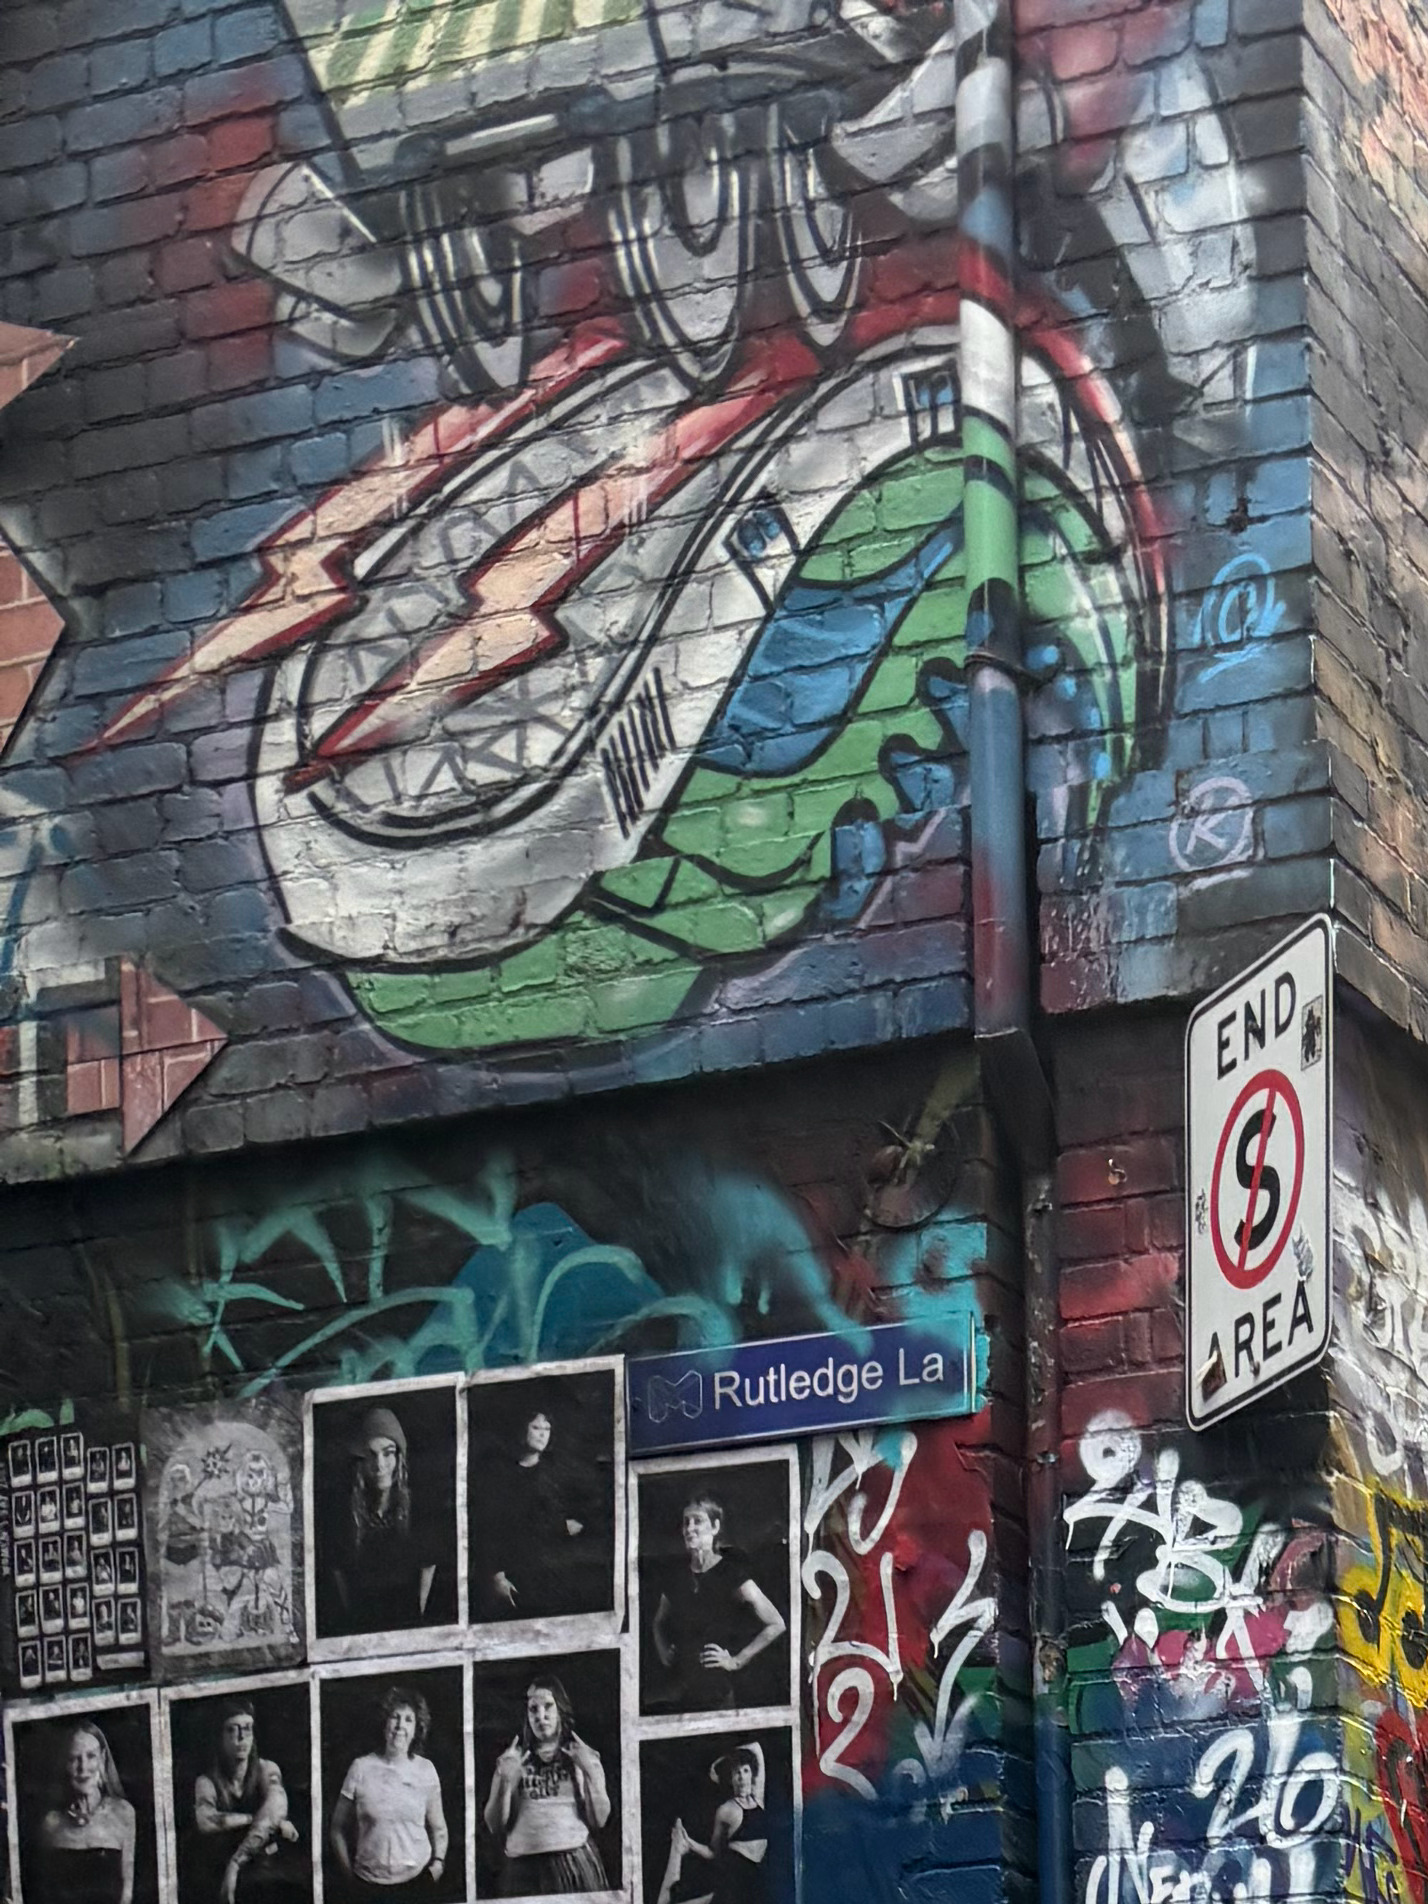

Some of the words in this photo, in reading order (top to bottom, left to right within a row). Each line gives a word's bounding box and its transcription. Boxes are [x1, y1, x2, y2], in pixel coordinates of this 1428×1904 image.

[1217, 970, 1297, 1081] END
[713, 1356, 884, 1411] Rutledge
[898, 1347, 945, 1386] La
